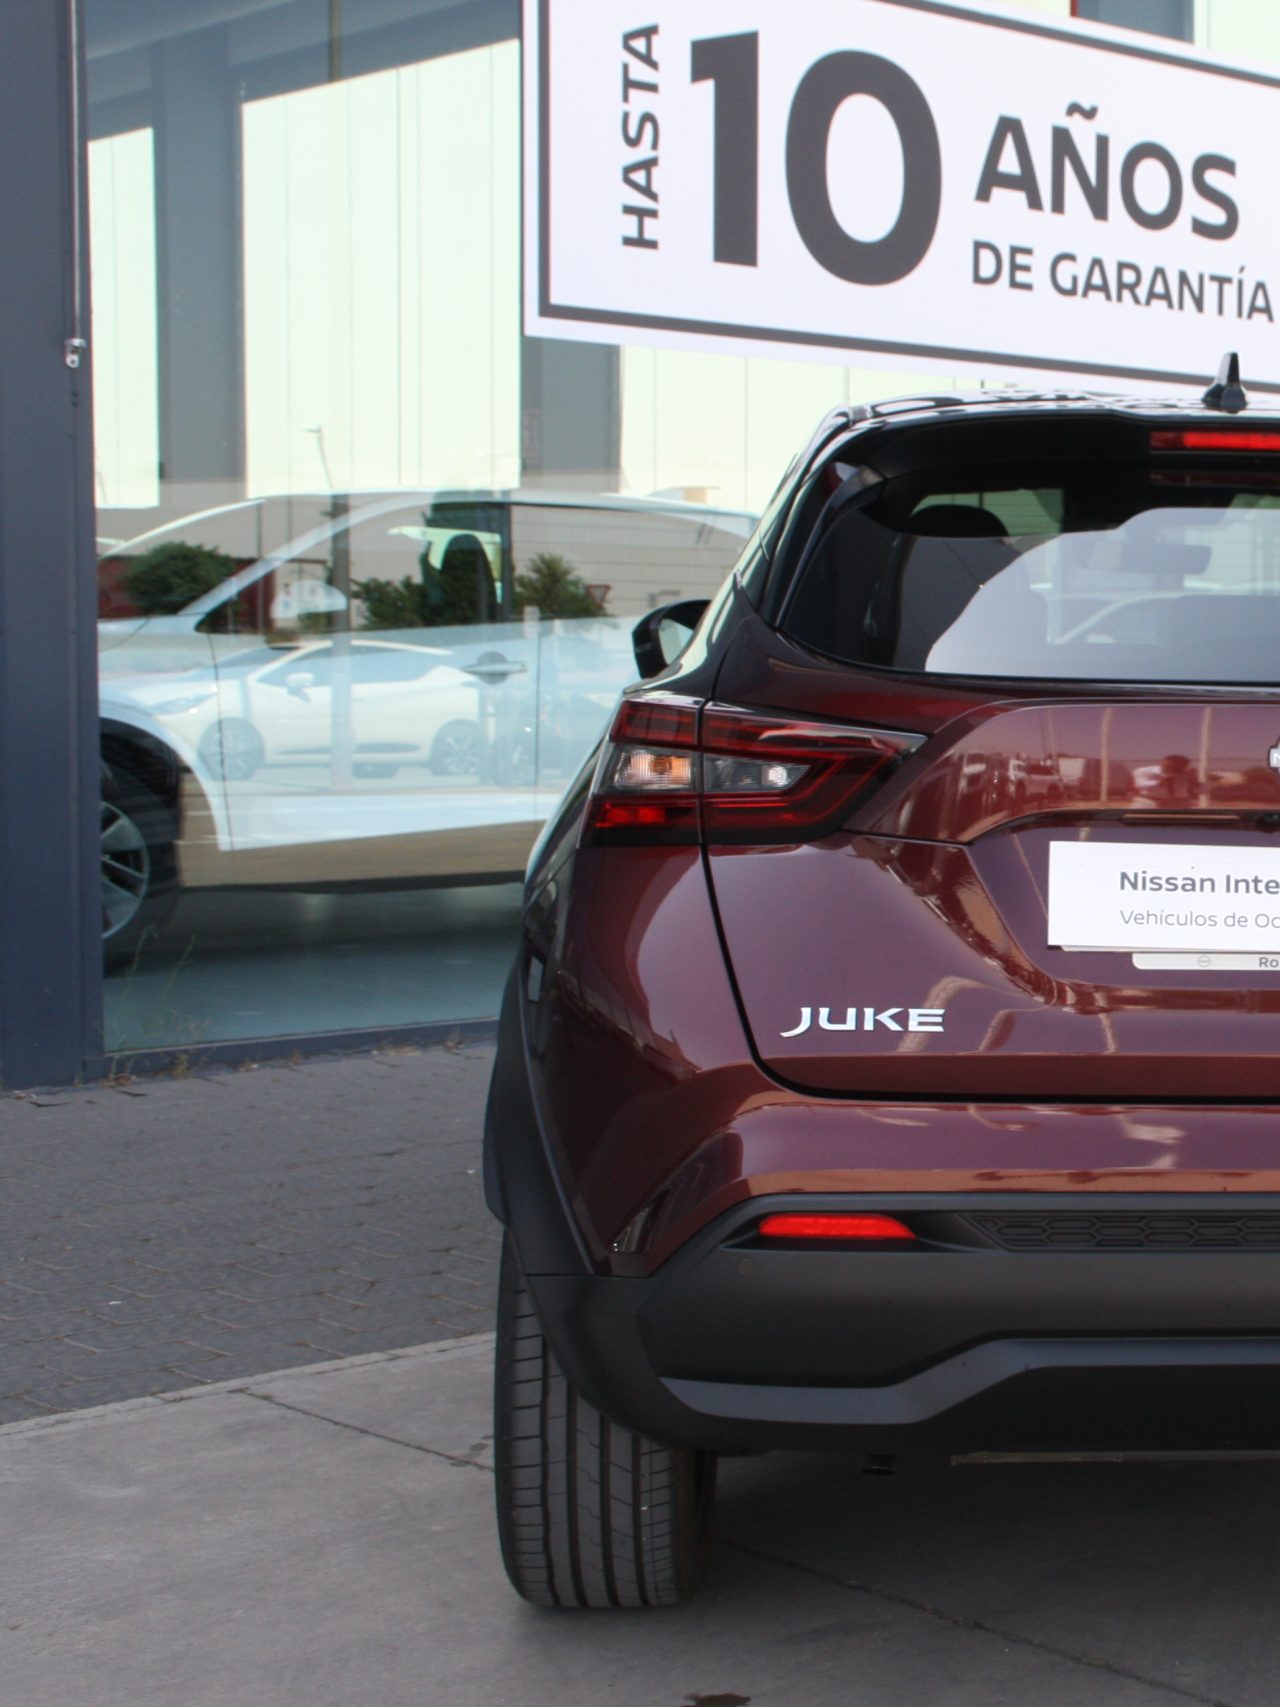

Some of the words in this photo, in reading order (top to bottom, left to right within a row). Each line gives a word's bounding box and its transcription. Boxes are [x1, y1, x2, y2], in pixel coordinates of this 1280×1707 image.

[621, 24, 660, 250] HASTA
[690, 30, 942, 286] 10
[974, 102, 1240, 241] AÑOS
[972, 240, 1033, 291] DE
[1050, 252, 1275, 324] GARANTÍA
[1120, 871, 1216, 893] Nissan
[1119, 910, 1218, 927] Vehículos
[1223, 912, 1249, 928] de
[779, 1007, 946, 1038] JUKE
